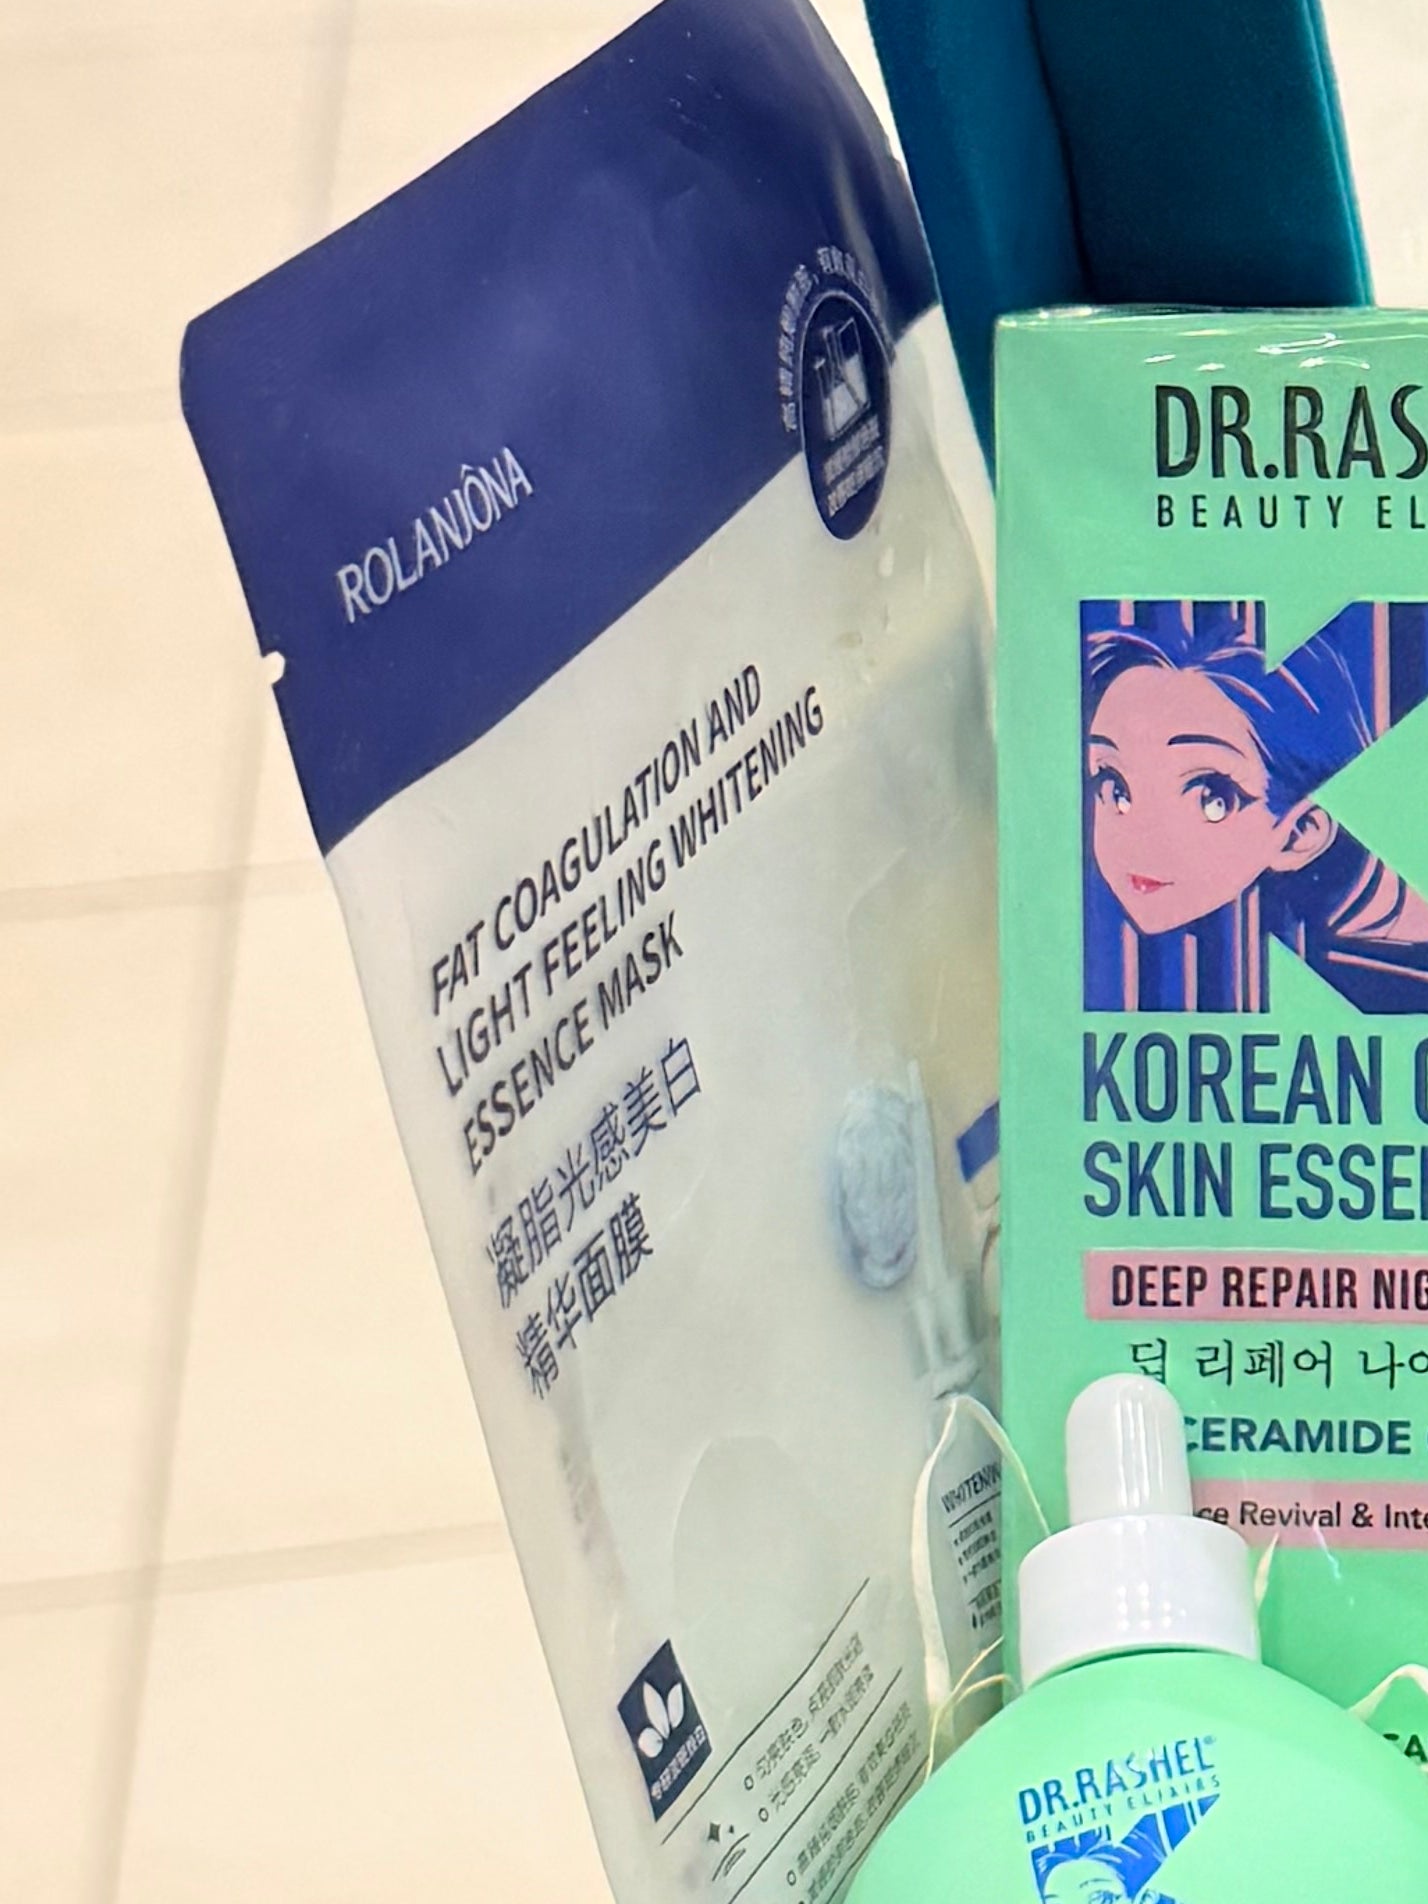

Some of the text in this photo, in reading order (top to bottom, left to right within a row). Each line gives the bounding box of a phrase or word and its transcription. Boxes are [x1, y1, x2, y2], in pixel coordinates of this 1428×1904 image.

[1156, 495, 1344, 530] BEAUTY
[431, 663, 761, 1016] FAT COAGULATION AND
[437, 685, 826, 1097] LIGHT FEELING WHITENING
[462, 910, 686, 1178] ESSENCE MASK
[1082, 1031, 1383, 1126] KOREAN
[1083, 1141, 1234, 1218] SKIN
[515, 1193, 654, 1400] 精华面膜
[1111, 1263, 1207, 1308] DEEP
[1222, 1265, 1358, 1312] REPAIR
[1196, 1338, 1333, 1388] 리페어
[1239, 1500, 1341, 1530] Revival
[1352, 1503, 1374, 1530] &
[1026, 1774, 1220, 1843] BEAUTY ELIXIRS
